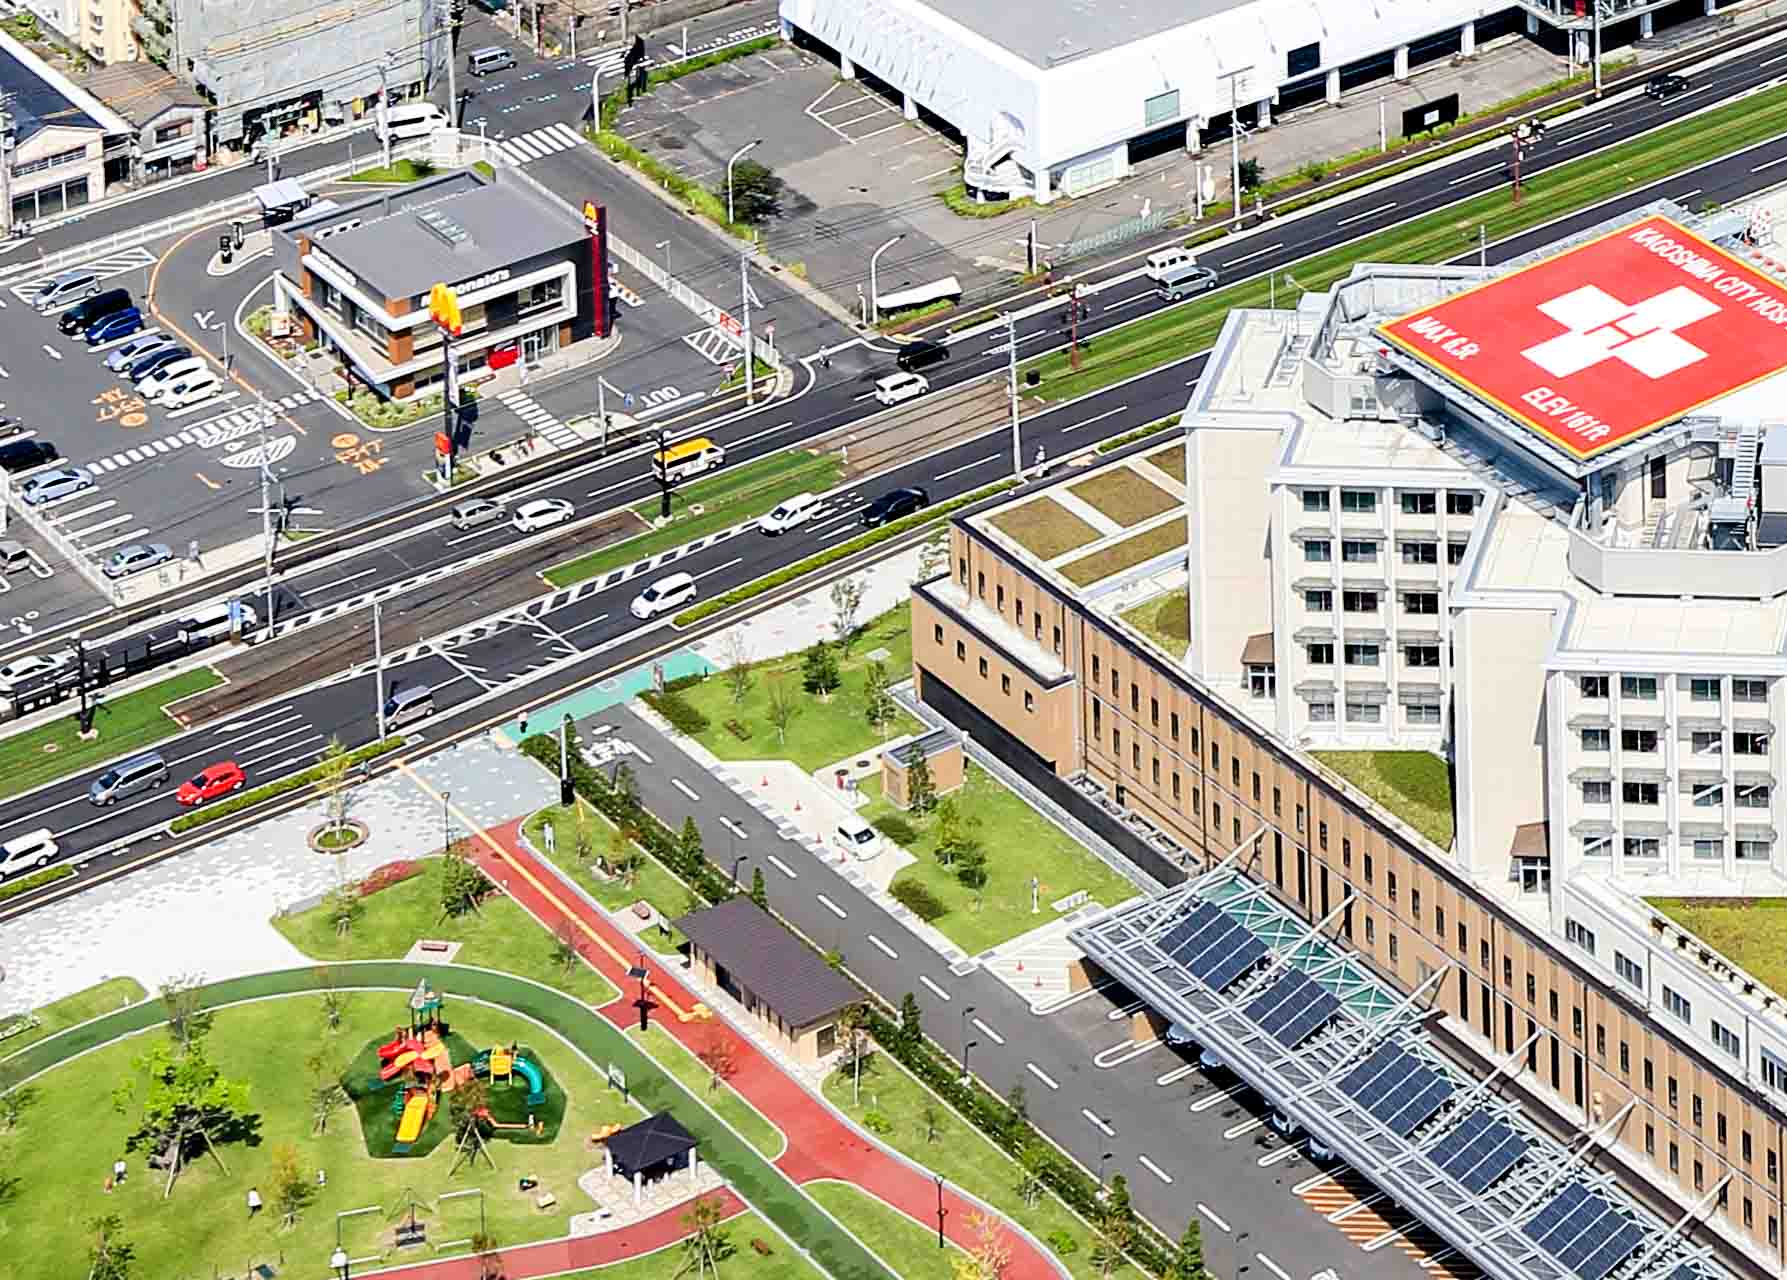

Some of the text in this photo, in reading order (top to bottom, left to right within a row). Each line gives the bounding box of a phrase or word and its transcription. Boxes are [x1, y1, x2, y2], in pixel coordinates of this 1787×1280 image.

[1629, 227, 1720, 283] KAGOSHIMA
[1713, 275, 1762, 308] CITY
[1407, 316, 1457, 344] MAX
[639, 385, 681, 409] OUT
[1520, 386, 1573, 417] ELEV
